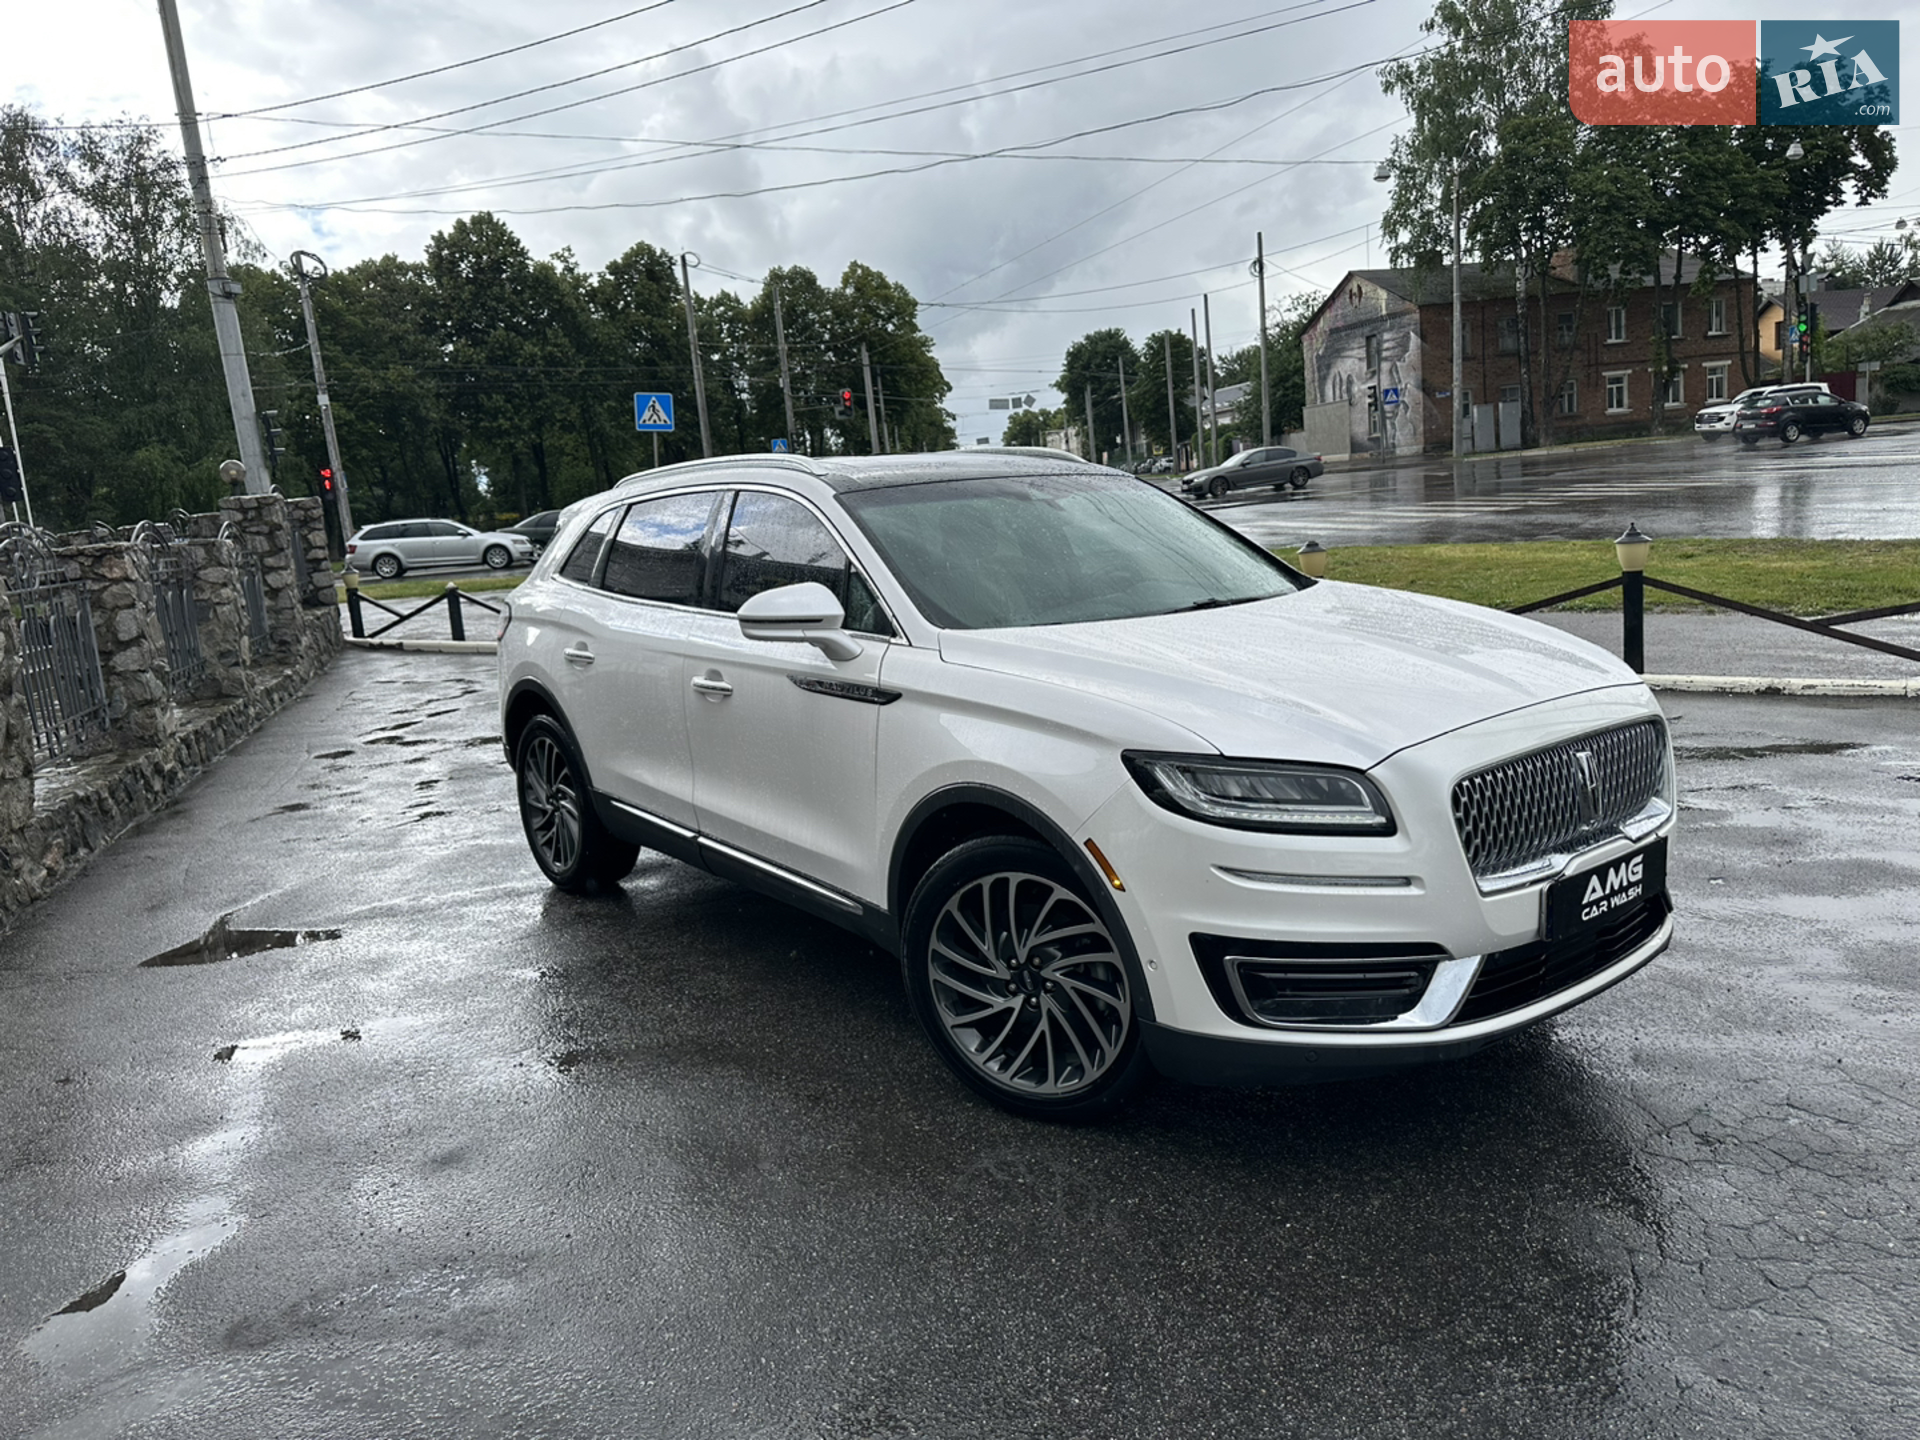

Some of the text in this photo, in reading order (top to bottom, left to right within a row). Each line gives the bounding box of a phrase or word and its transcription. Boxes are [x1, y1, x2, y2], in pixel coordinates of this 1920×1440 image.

[1581, 853, 1644, 905] AMG
[1581, 883, 1642, 921] CAR WASH
